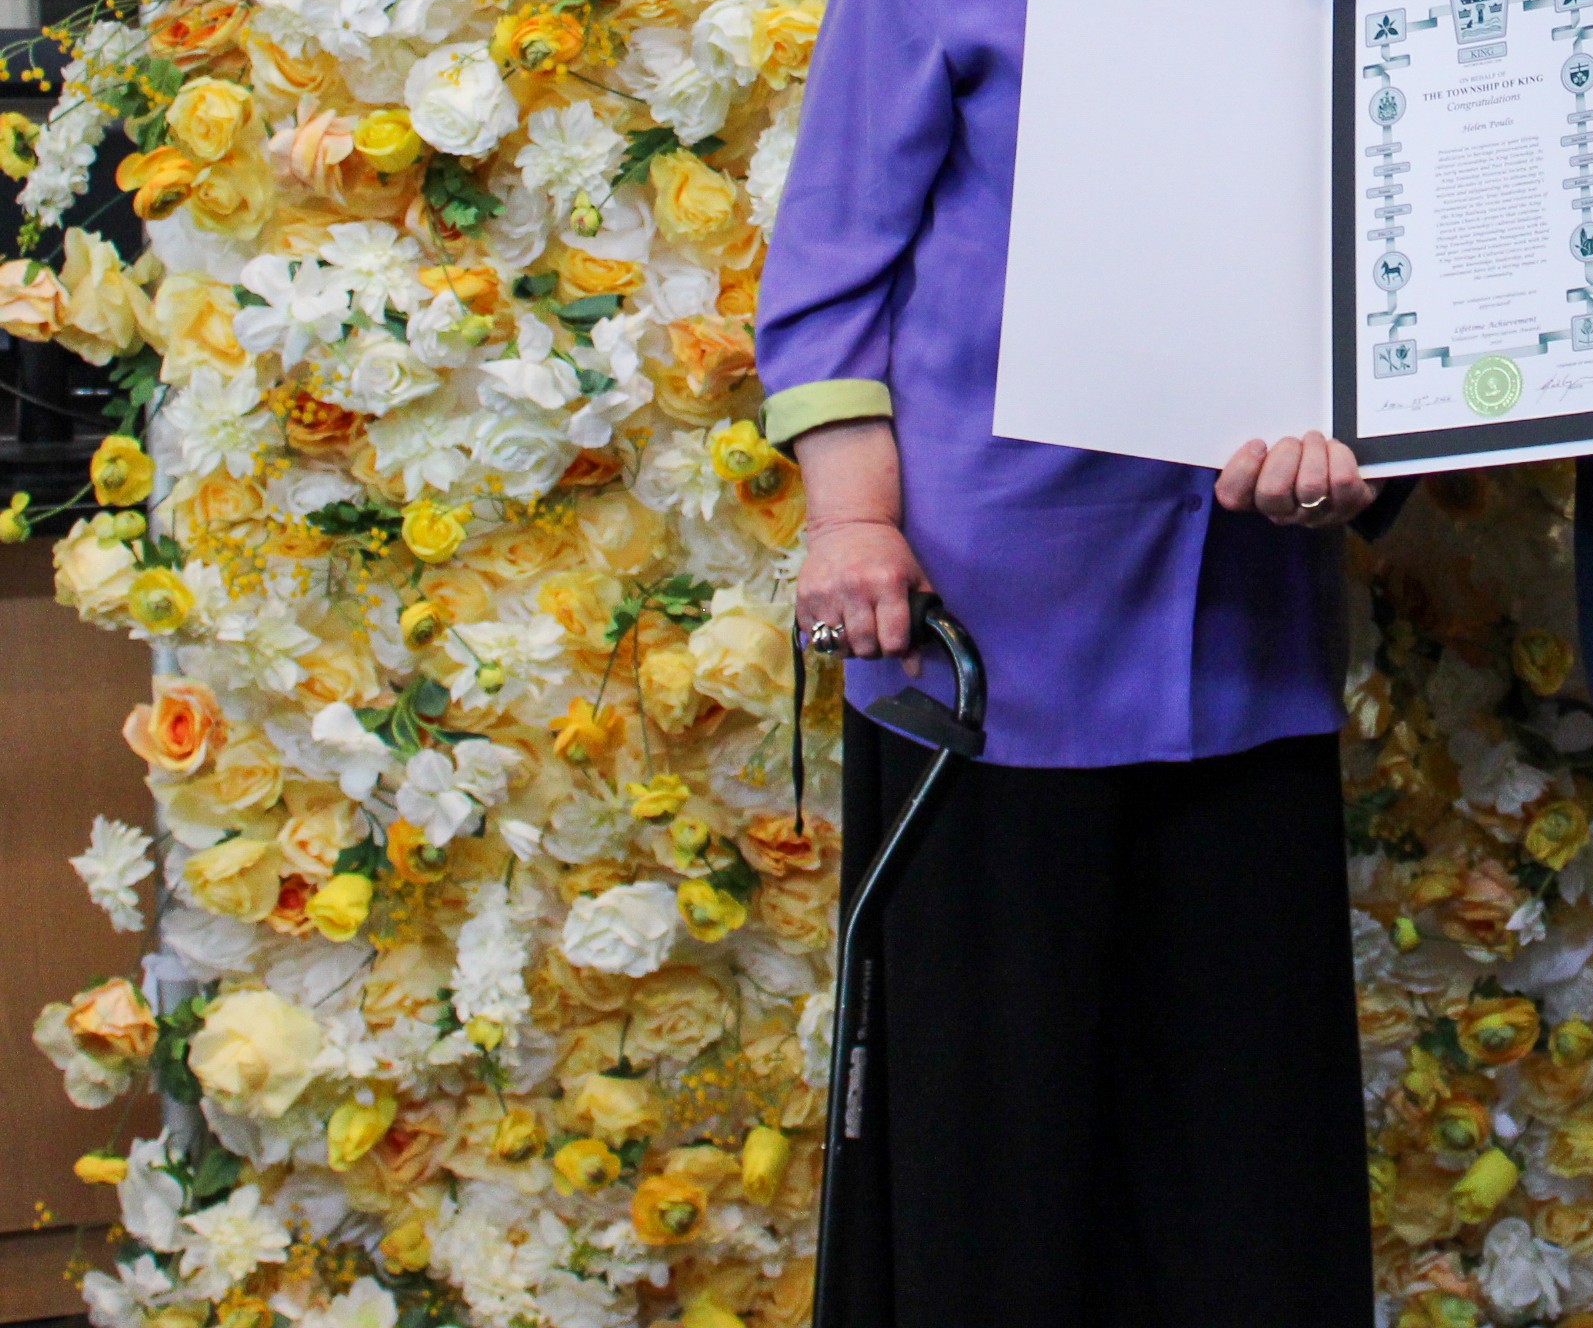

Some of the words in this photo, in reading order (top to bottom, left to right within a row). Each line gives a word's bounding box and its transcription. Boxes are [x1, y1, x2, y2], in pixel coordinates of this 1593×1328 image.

[1470, 47, 1494, 59] KING
[1423, 91, 1443, 102] THE
[1446, 82, 1500, 98] TOWNSHIP
[1502, 80, 1515, 89] OF
[1518, 74, 1544, 86] KING
[1446, 93, 1521, 112] Congratulations
